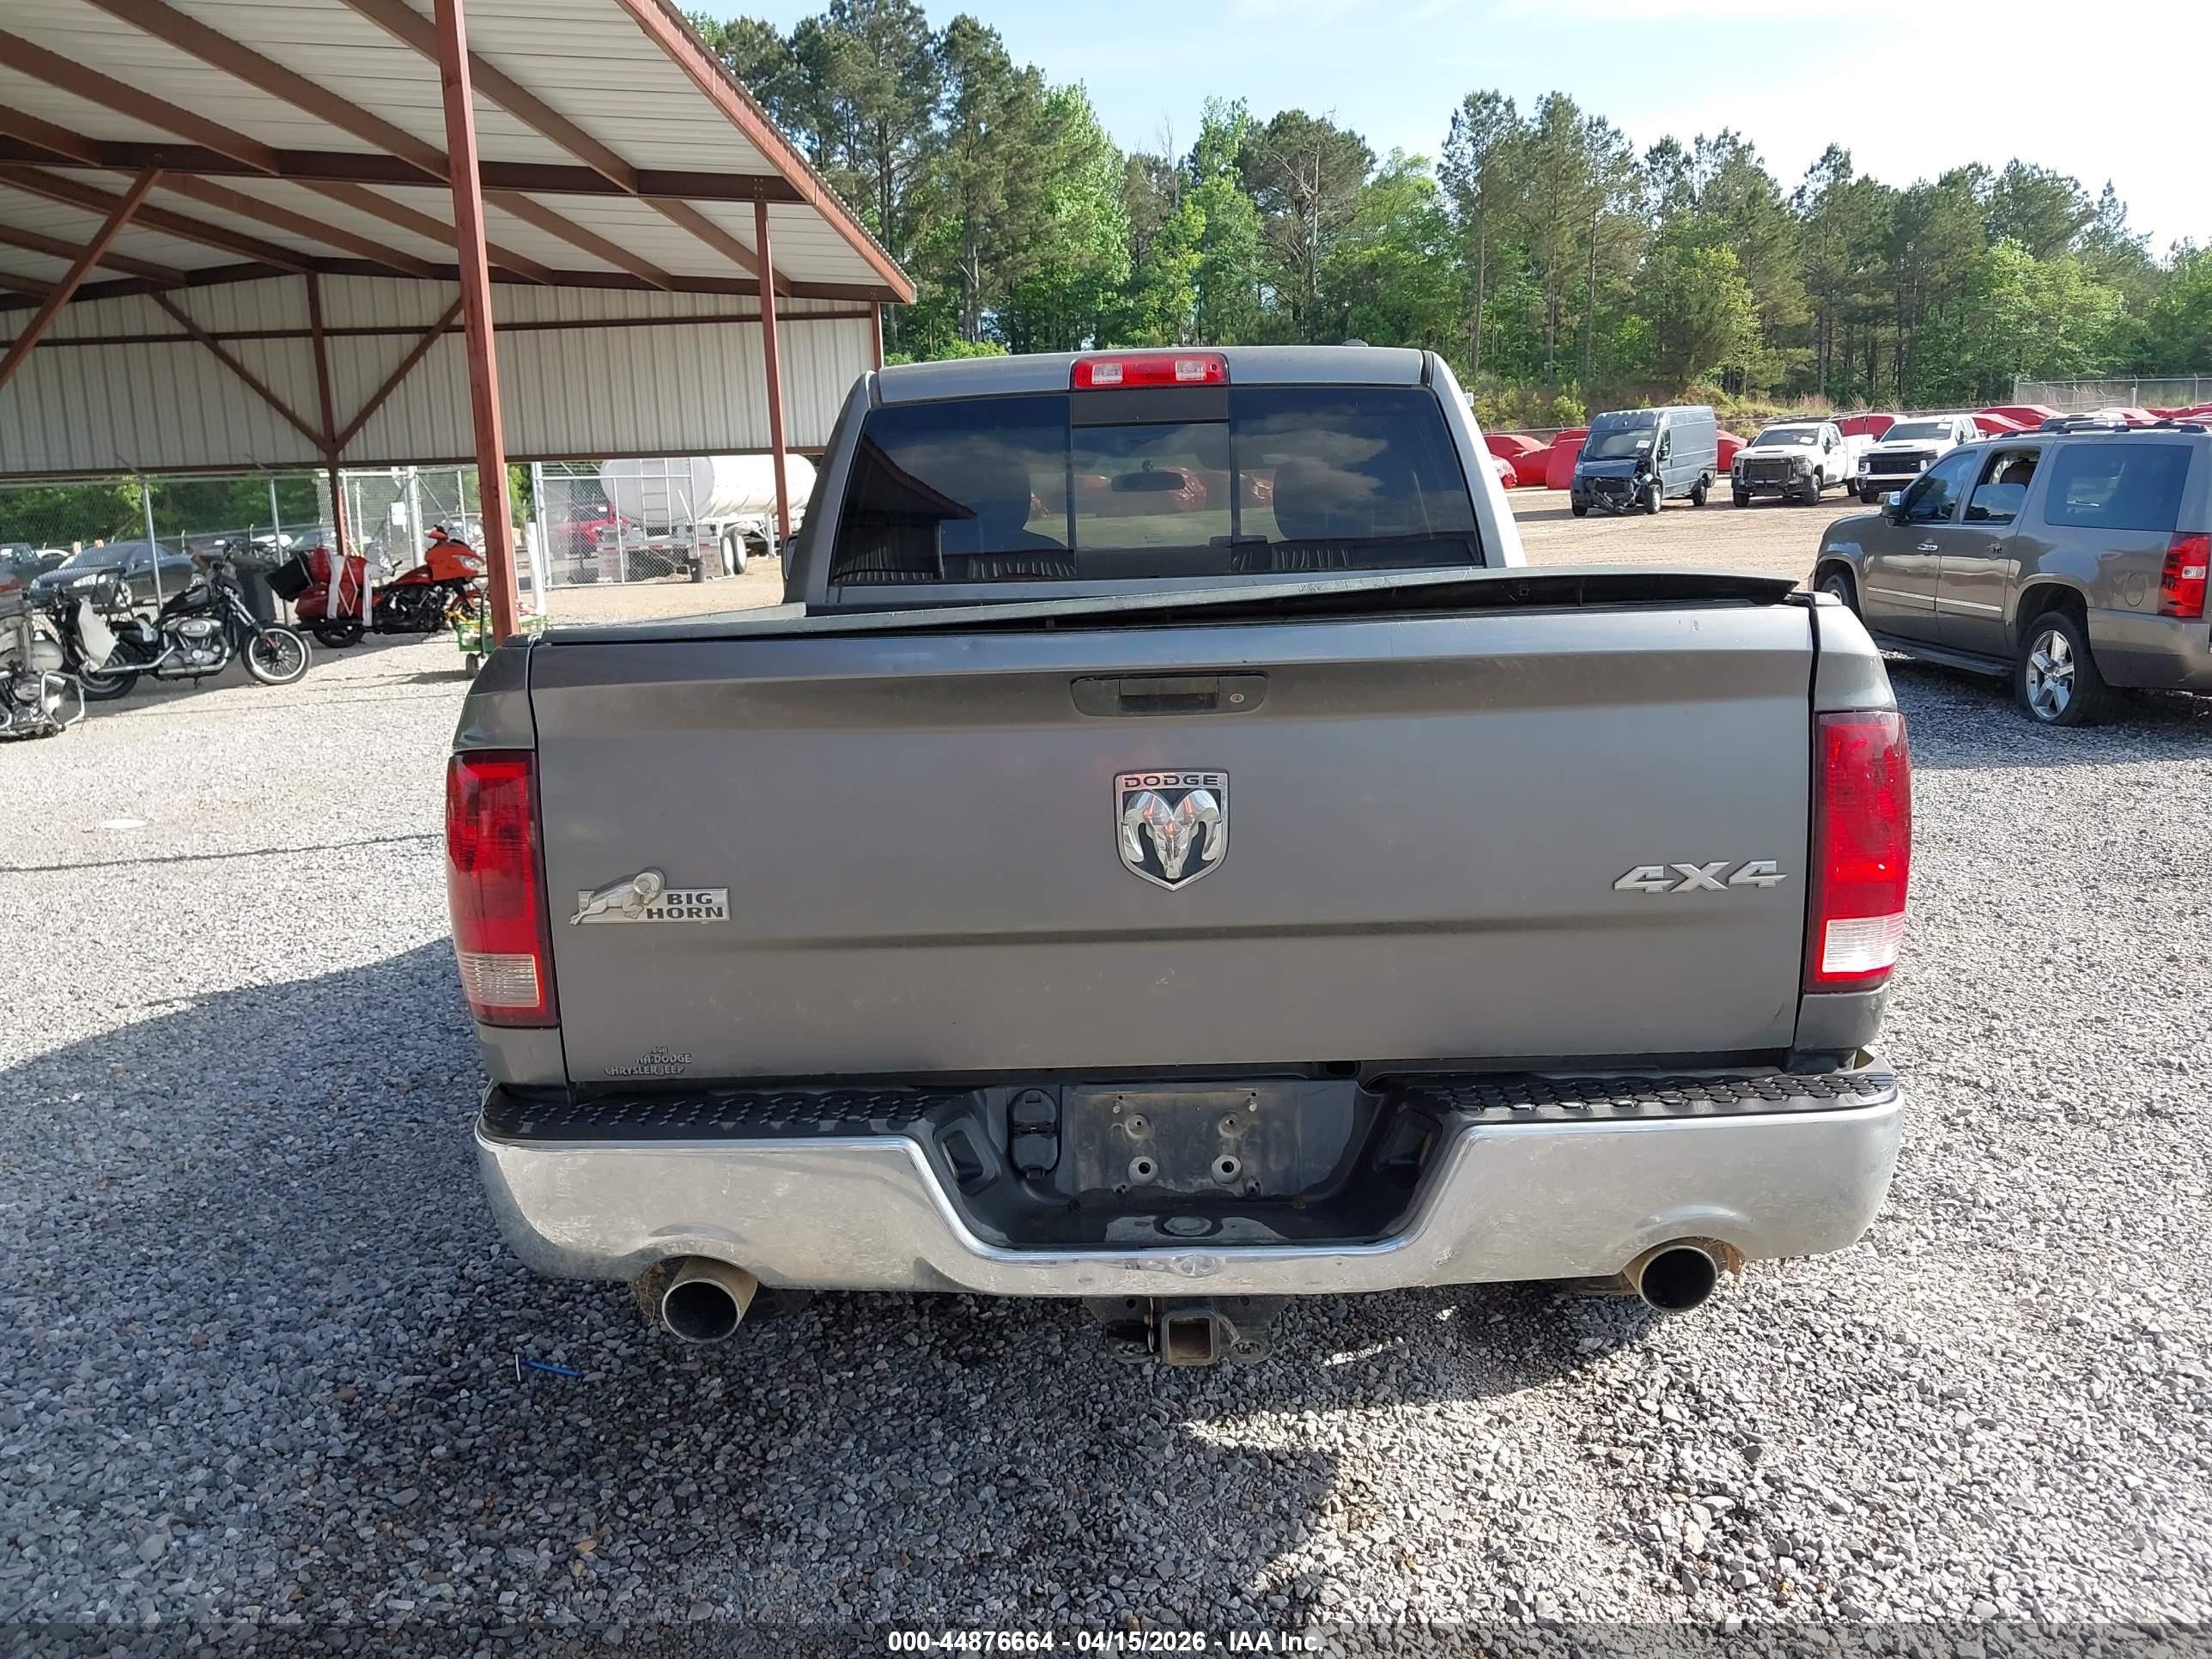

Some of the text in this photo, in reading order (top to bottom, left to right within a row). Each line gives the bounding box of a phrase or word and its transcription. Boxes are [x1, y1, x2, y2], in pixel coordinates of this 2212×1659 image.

[1124, 775, 1218, 787] DODGE
[1613, 860, 1789, 894] 4X4
[666, 893, 713, 905] BIG
[646, 907, 724, 919] HORN
